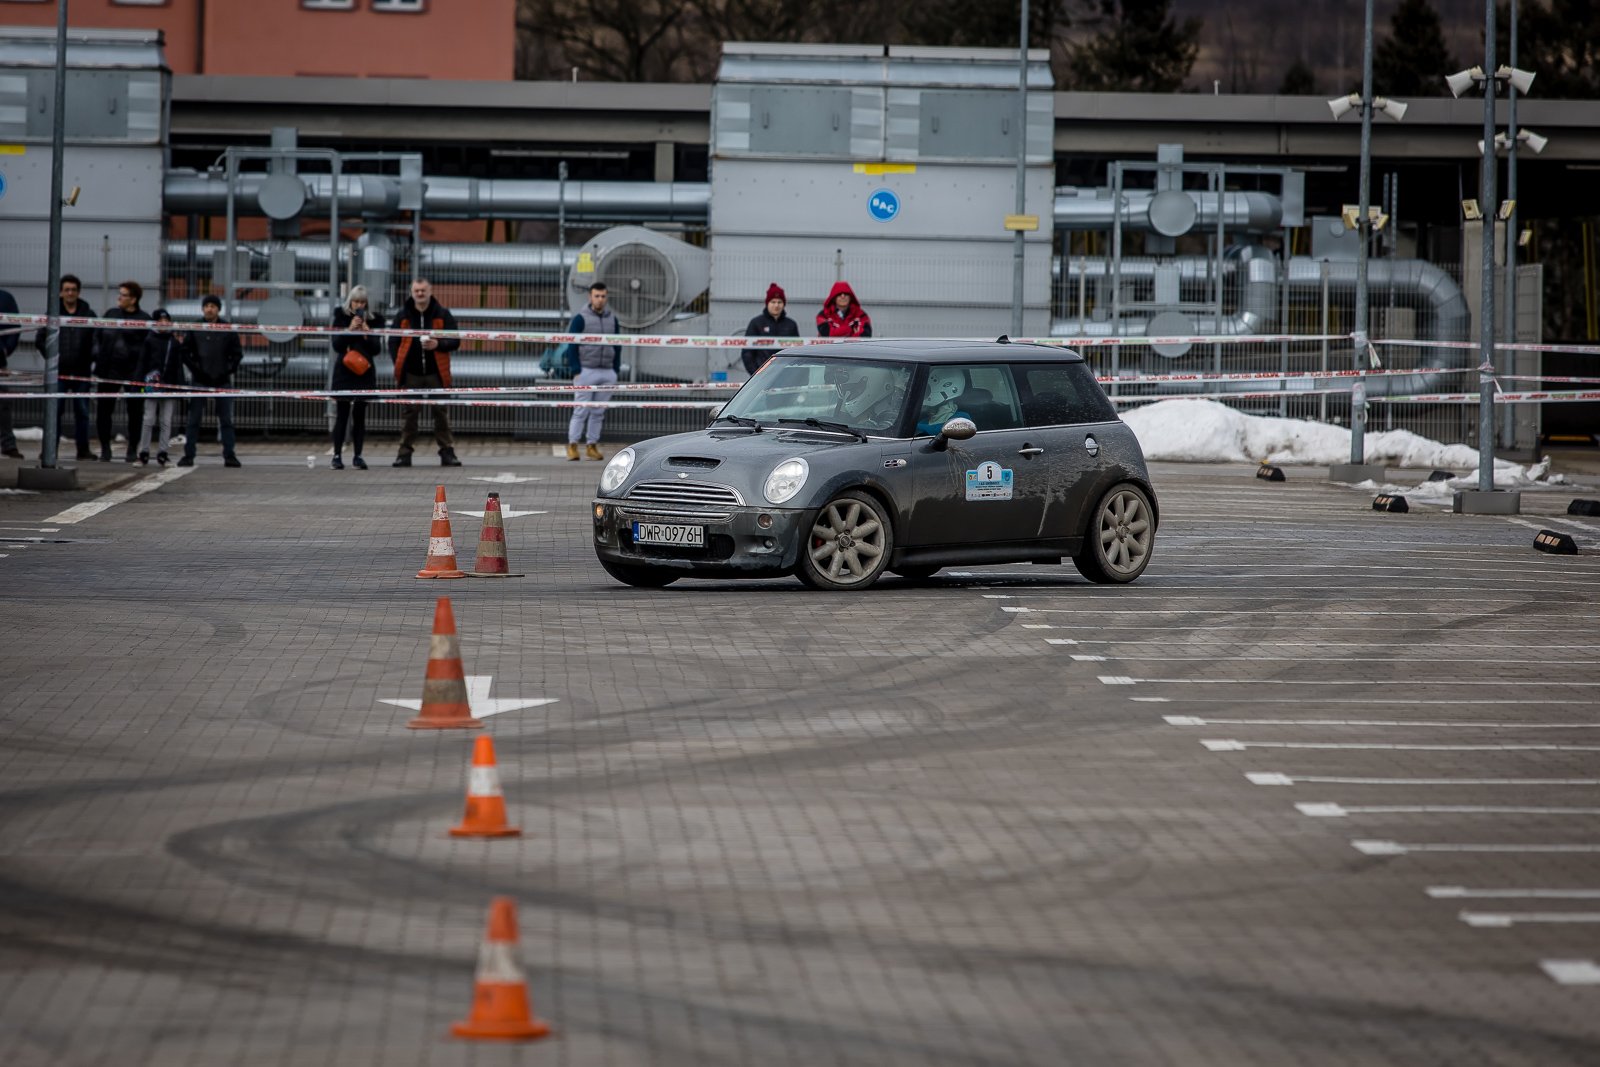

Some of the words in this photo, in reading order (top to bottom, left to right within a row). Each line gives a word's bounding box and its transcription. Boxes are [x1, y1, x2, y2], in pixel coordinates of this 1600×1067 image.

[986, 466, 992, 480] 5
[639, 524, 660, 541] DWR
[664, 526, 702, 543] 0976H
